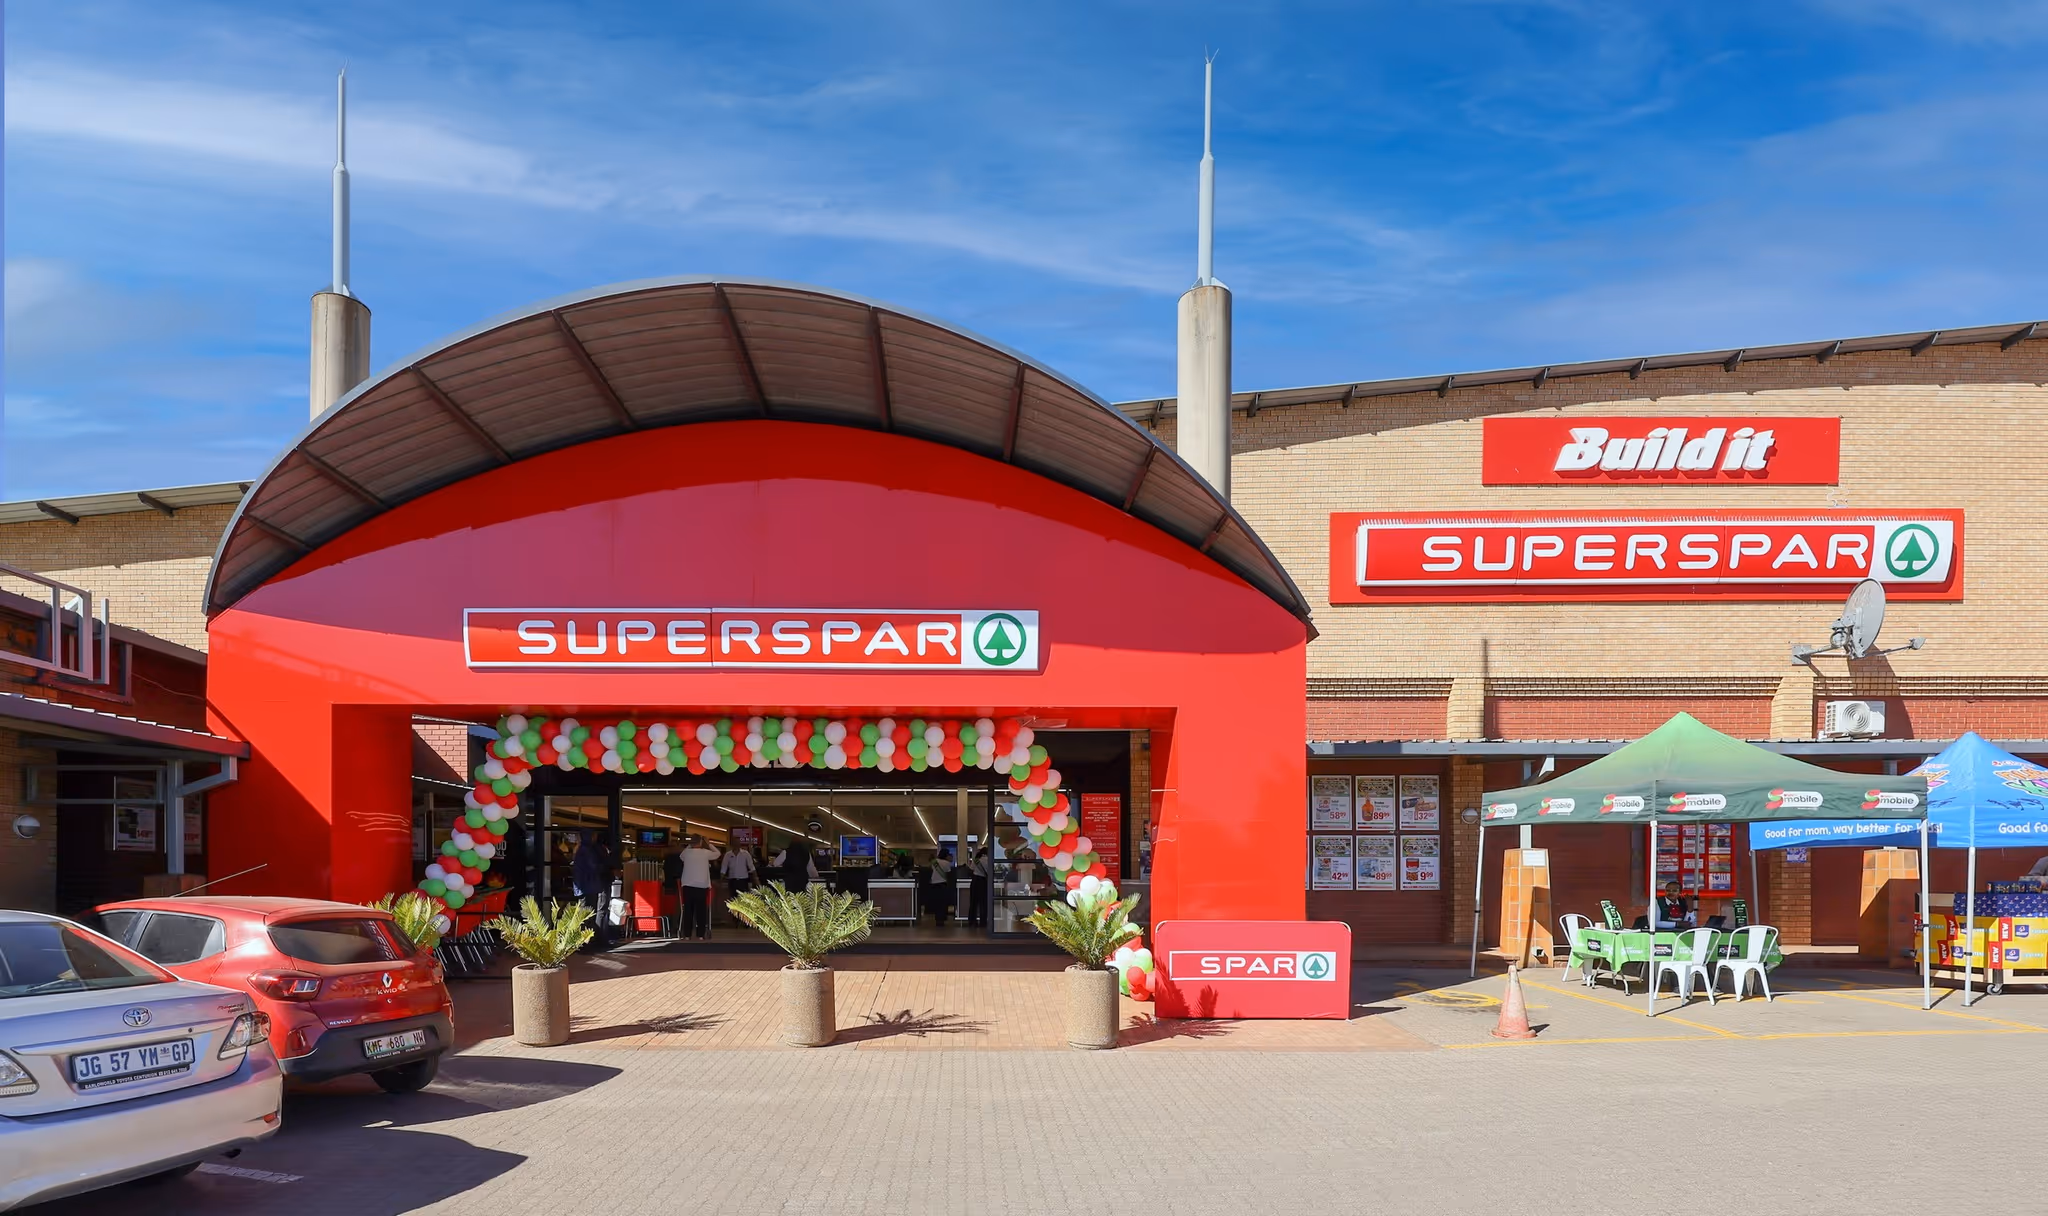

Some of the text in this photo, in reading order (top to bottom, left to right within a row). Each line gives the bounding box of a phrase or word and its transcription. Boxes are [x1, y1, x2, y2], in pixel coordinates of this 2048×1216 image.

[1553, 427, 1775, 472] Build it
[1421, 533, 1869, 572] SUPERSPAR
[516, 619, 957, 656] SUPERSPAR
[1550, 801, 1572, 809] mobile
[1614, 800, 1640, 808] mobile
[1687, 797, 1721, 806] mobile
[1784, 795, 1818, 803] mobile
[1880, 796, 1914, 804] mobile
[1765, 828, 1786, 838] Good
[1788, 827, 1802, 836] for
[1805, 826, 1831, 836] mom,
[1833, 825, 1854, 835] way
[1856, 823, 1891, 833] better
[1895, 823, 1913, 833] for
[1998, 821, 2031, 834] Good
[1200, 957, 1294, 975] SPAR
[377, 987, 398, 995] KWID
[366, 1039, 383, 1054] KMF
[390, 1035, 406, 1049] 680
[412, 1031, 425, 1045] NW
[80, 1042, 190, 1077] JG 57 YM GP
[133, 1072, 158, 1081] CENTURION
